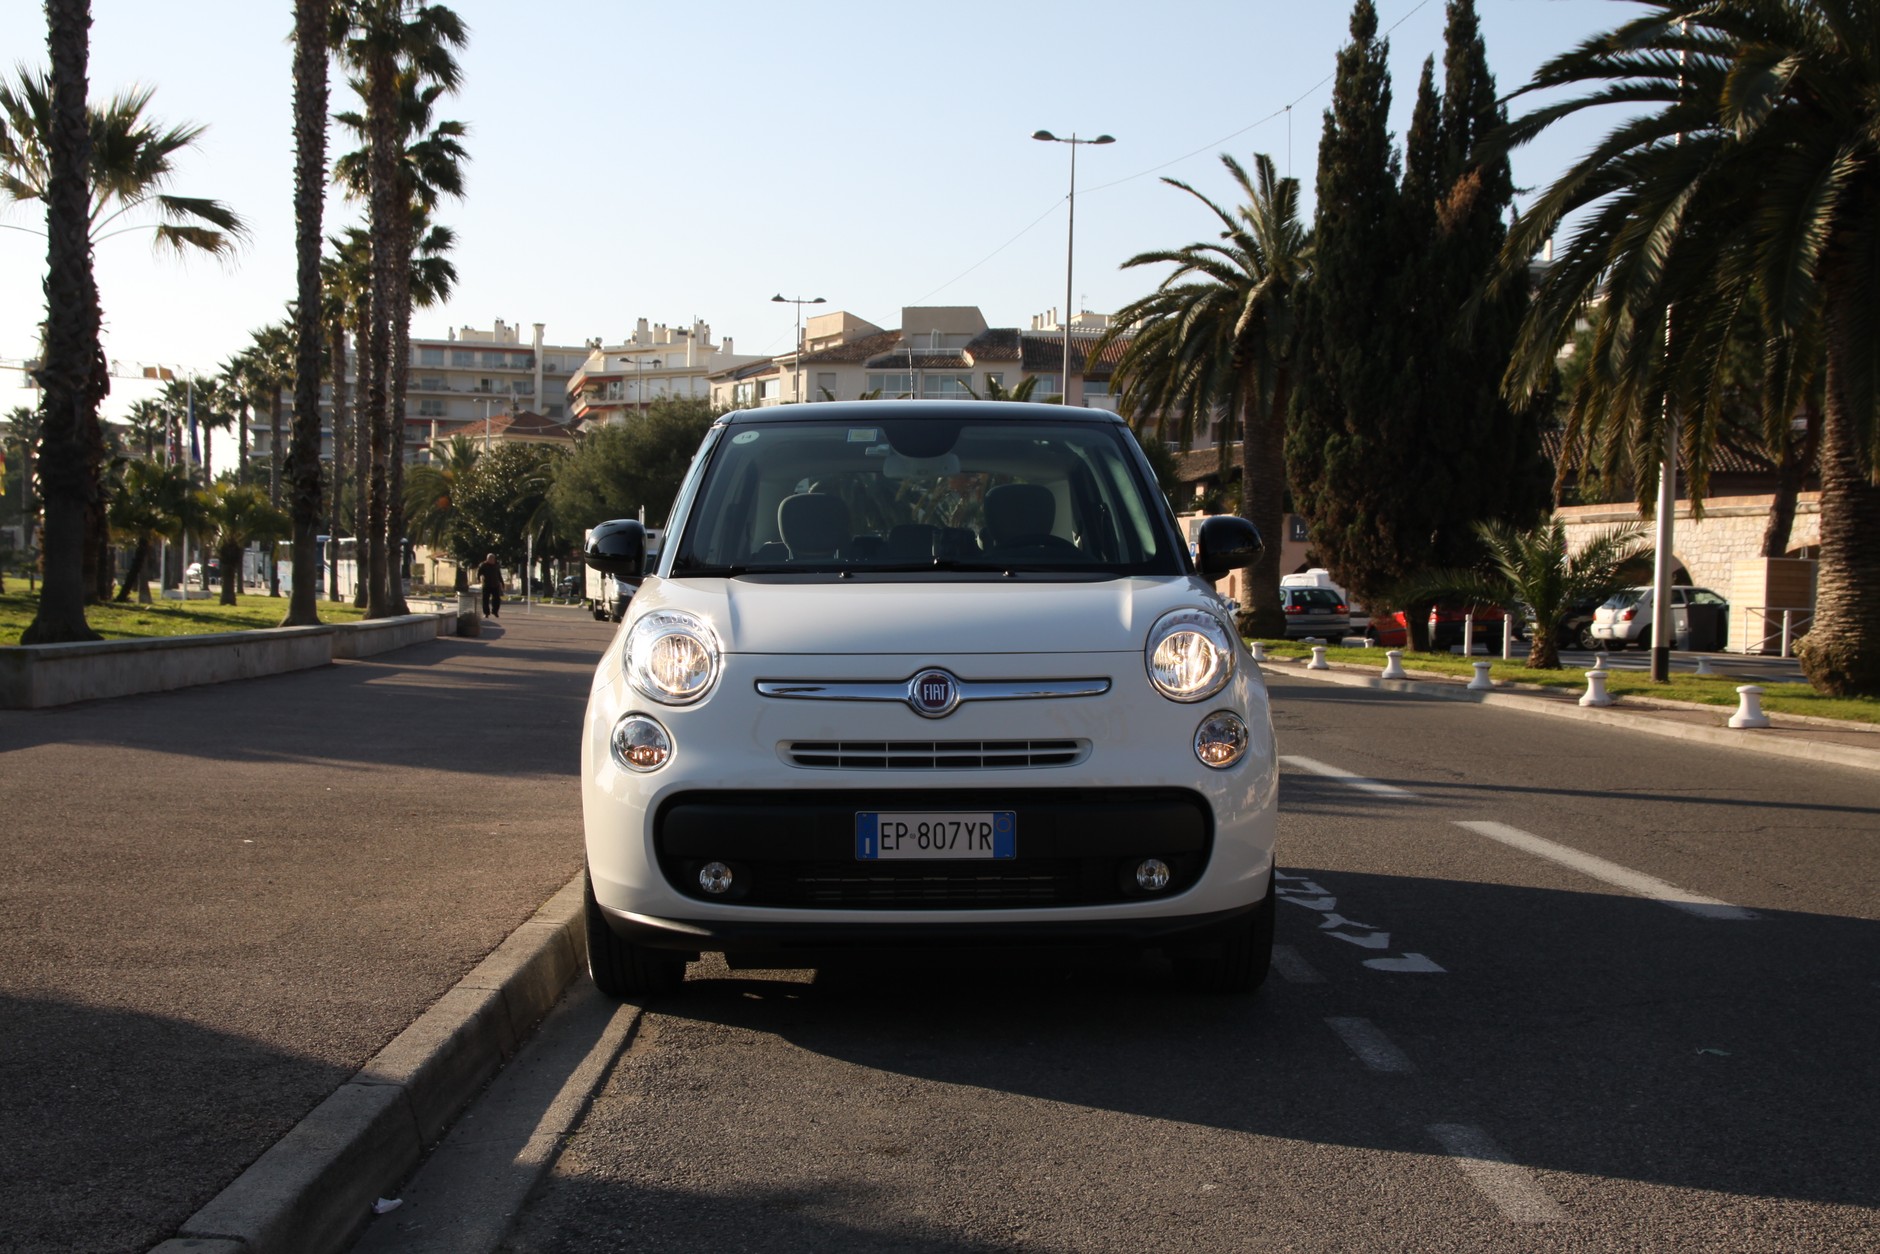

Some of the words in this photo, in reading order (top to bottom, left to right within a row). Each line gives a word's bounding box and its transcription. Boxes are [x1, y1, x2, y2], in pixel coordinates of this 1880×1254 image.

[923, 684, 946, 701] FIAT
[881, 822, 908, 850] EP
[918, 822, 992, 850] 807YR
